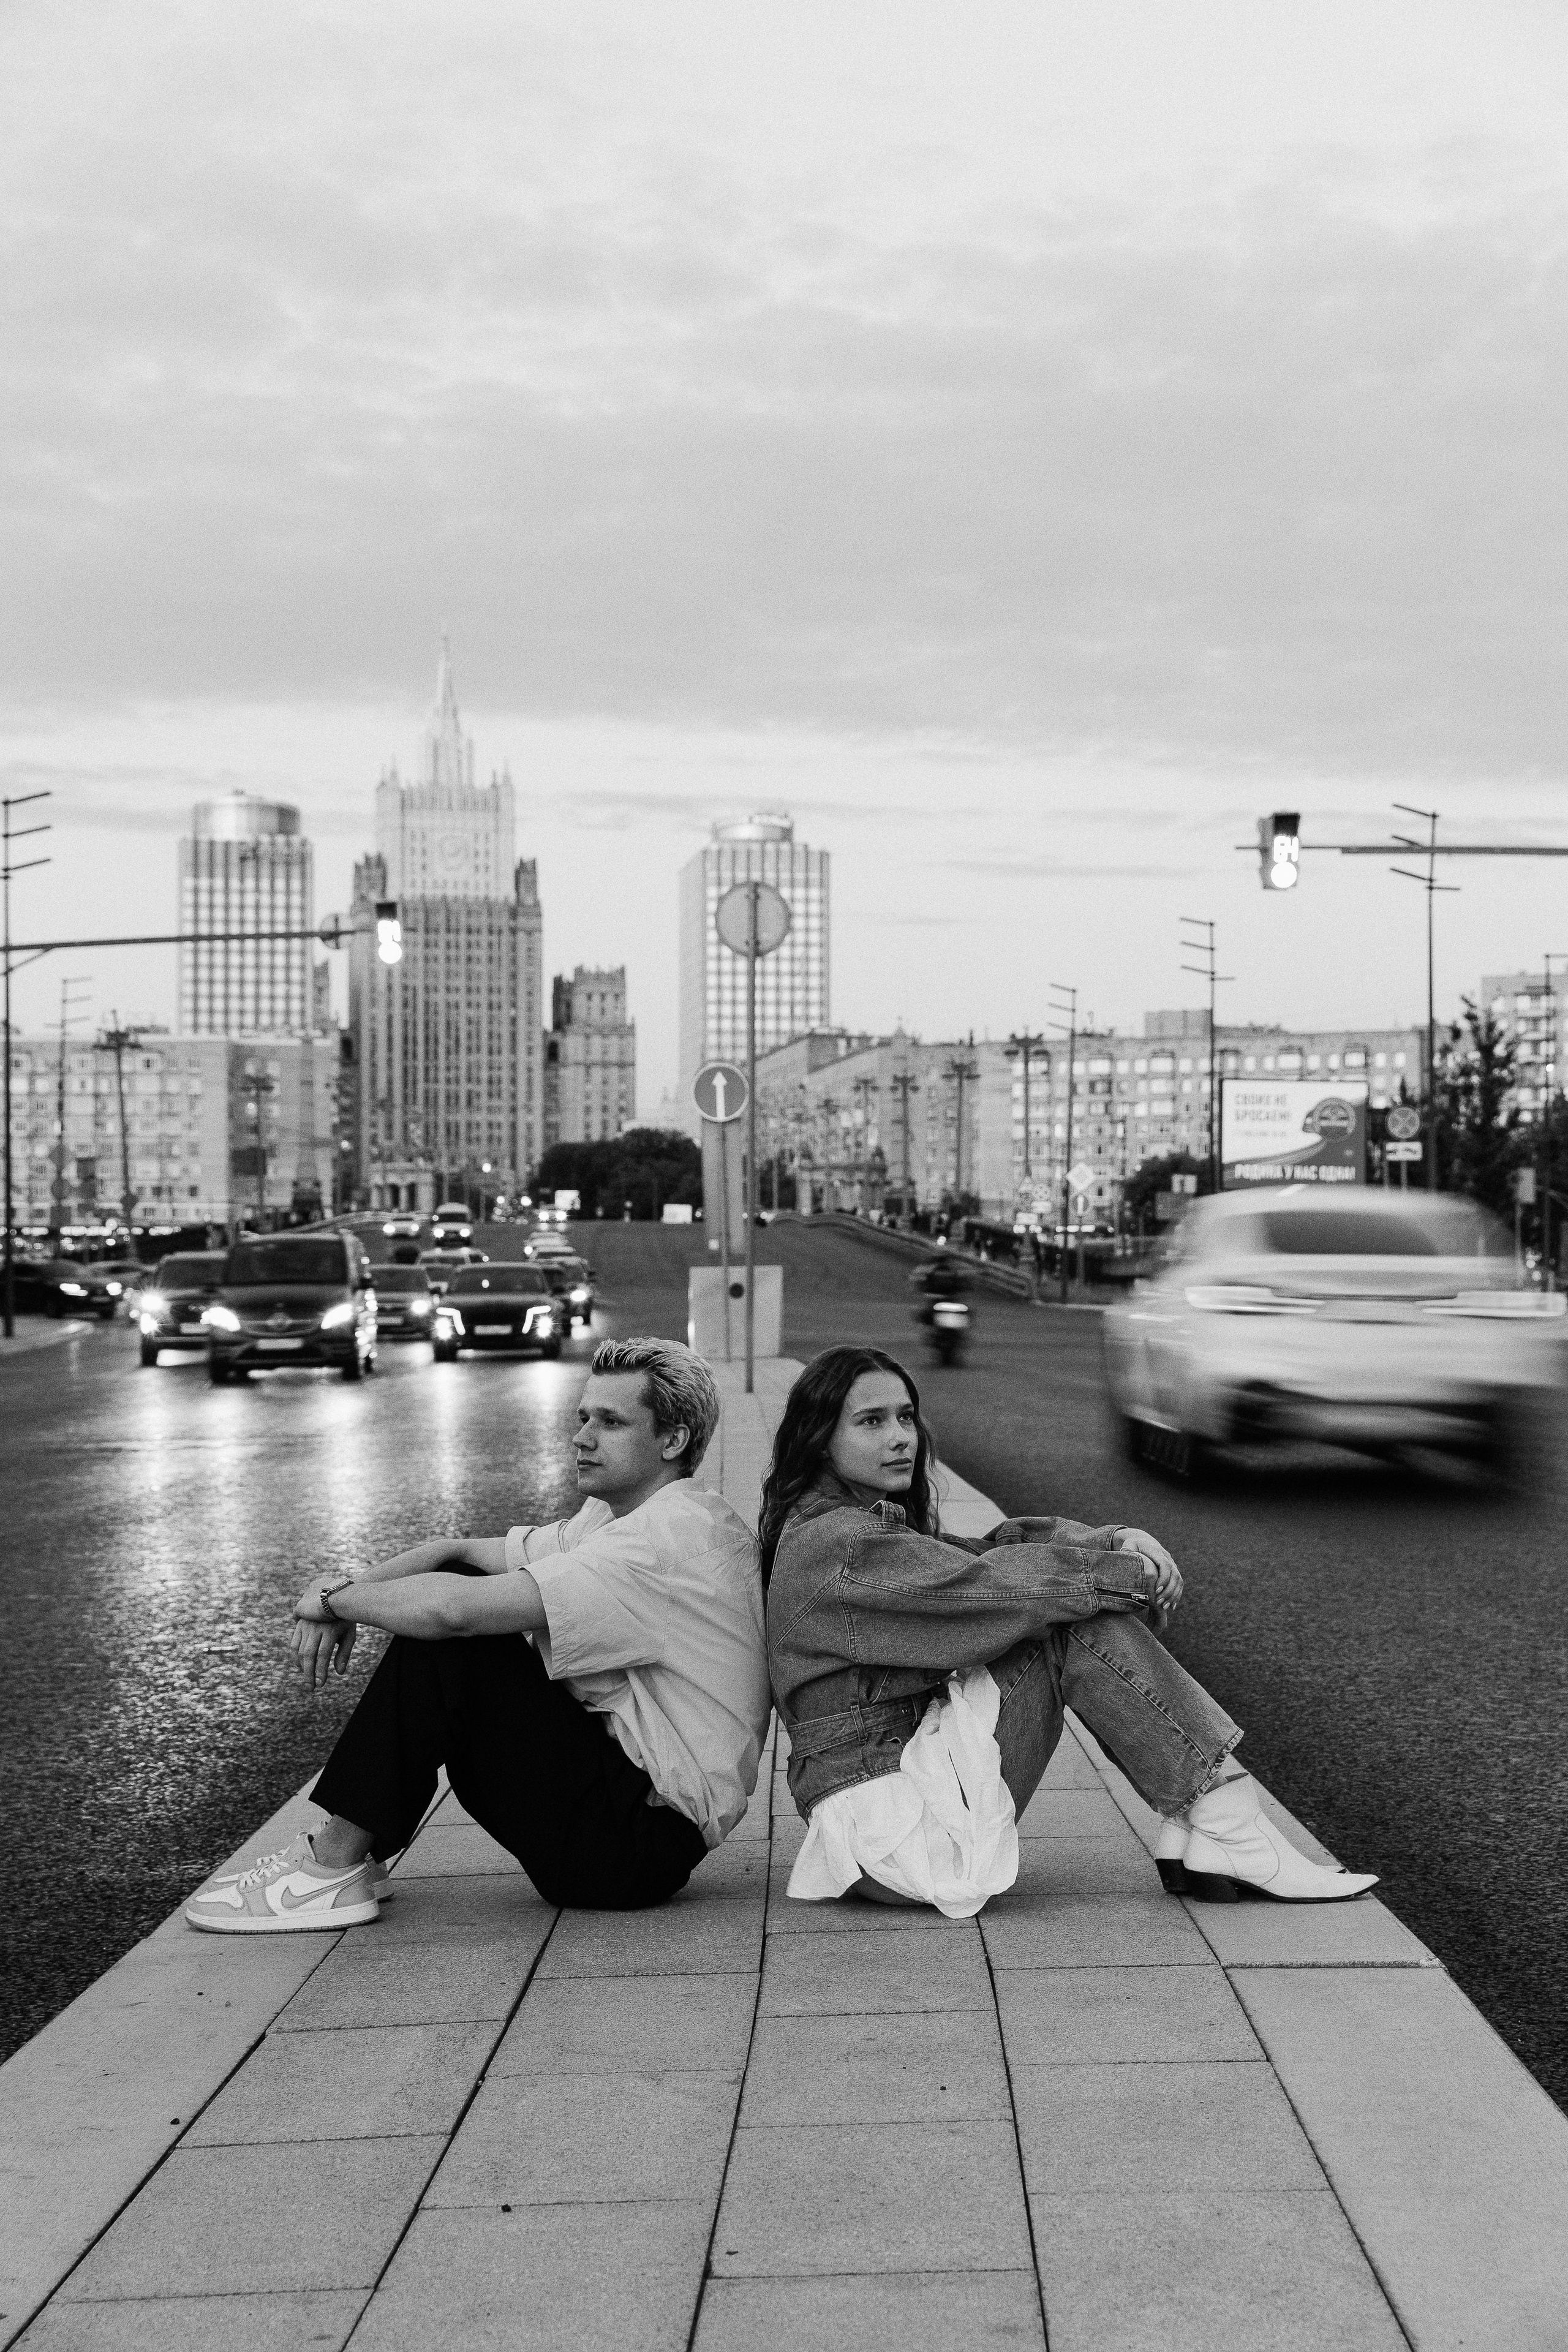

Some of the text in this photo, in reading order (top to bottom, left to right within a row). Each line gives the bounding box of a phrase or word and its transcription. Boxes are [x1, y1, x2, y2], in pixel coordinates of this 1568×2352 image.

[1275, 1093, 1287, 1106] НЕ
[1235, 1164, 1283, 1180] РОДИНА
[1283, 1164, 1293, 1180] У
[1294, 1164, 1317, 1180] НАС
